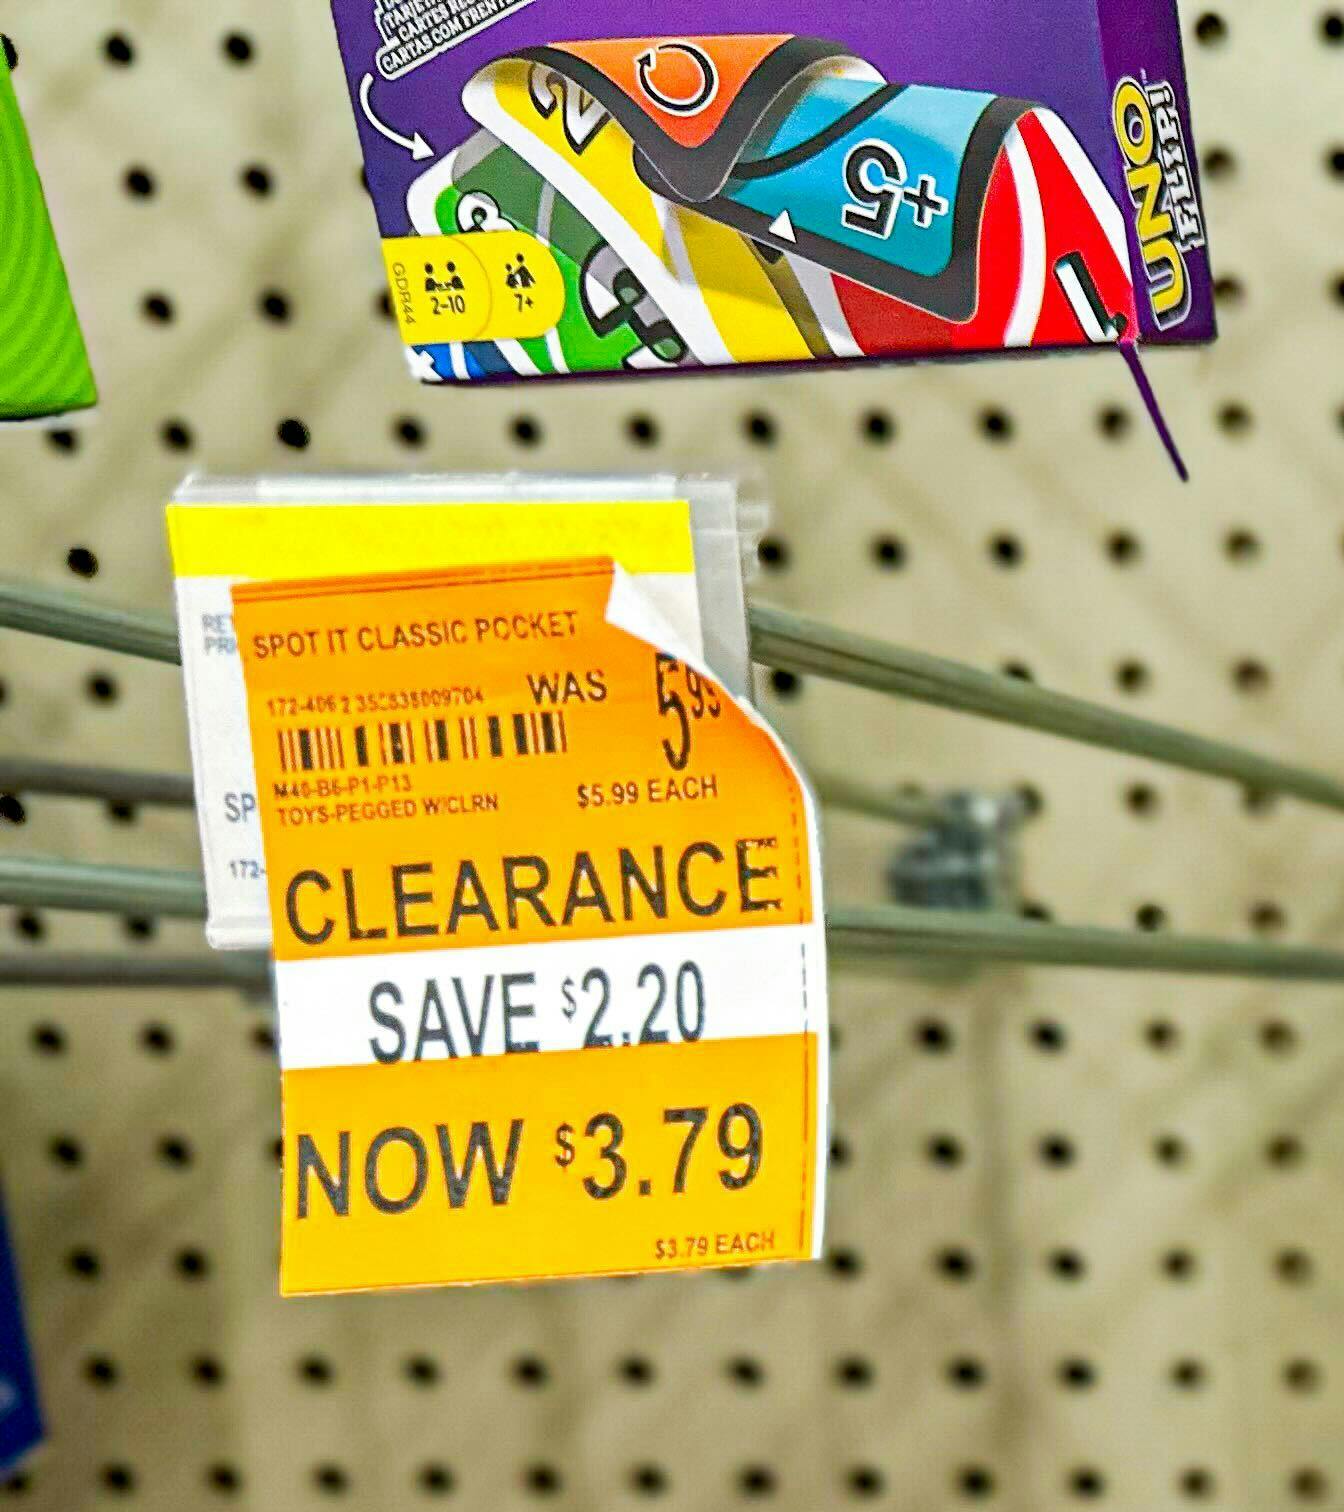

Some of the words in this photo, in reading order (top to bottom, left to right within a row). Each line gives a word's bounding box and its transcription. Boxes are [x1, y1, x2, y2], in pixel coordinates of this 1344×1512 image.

[431, 18, 464, 45] COM
[1112, 75, 1193, 332] UNO
[430, 294, 467, 316] 2-10
[513, 293, 535, 313] 7+
[253, 630, 320, 660] SPOT
[327, 626, 350, 655] IT
[357, 619, 468, 652] CLASSIC
[476, 610, 578, 643] POCKET
[526, 669, 607, 705] WAS
[575, 780, 639, 809] $5.99
[646, 774, 719, 803] EACH
[276, 799, 417, 829] TOYS-PEGGED
[284, 836, 783, 946] CLEARANCE
[368, 971, 540, 1066] SAVE
[560, 960, 707, 1051] $2.20
[295, 1118, 526, 1221] NOW
[554, 1102, 763, 1203] $3.79
[653, 1235, 710, 1262] $3.79
[715, 1230, 775, 1257] EACH
